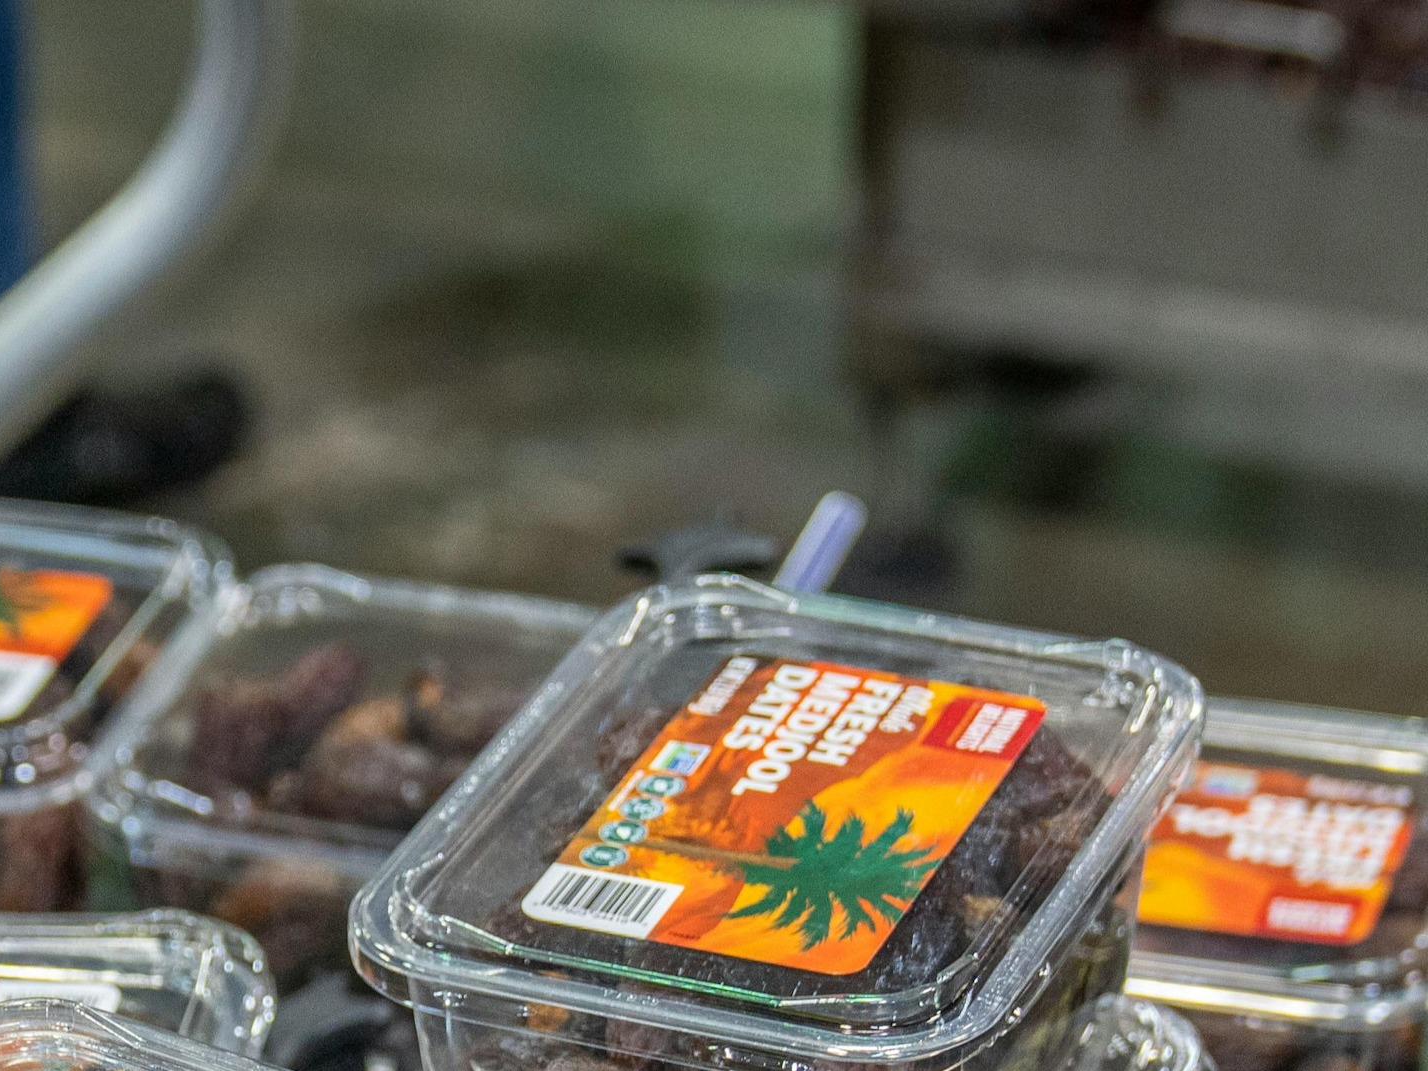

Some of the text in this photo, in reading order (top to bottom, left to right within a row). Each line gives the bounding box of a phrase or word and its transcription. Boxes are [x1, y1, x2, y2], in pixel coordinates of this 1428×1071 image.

[724, 665, 817, 749] DATES
[733, 672, 858, 793] MEDJOOL
[809, 680, 901, 764] FRESH
